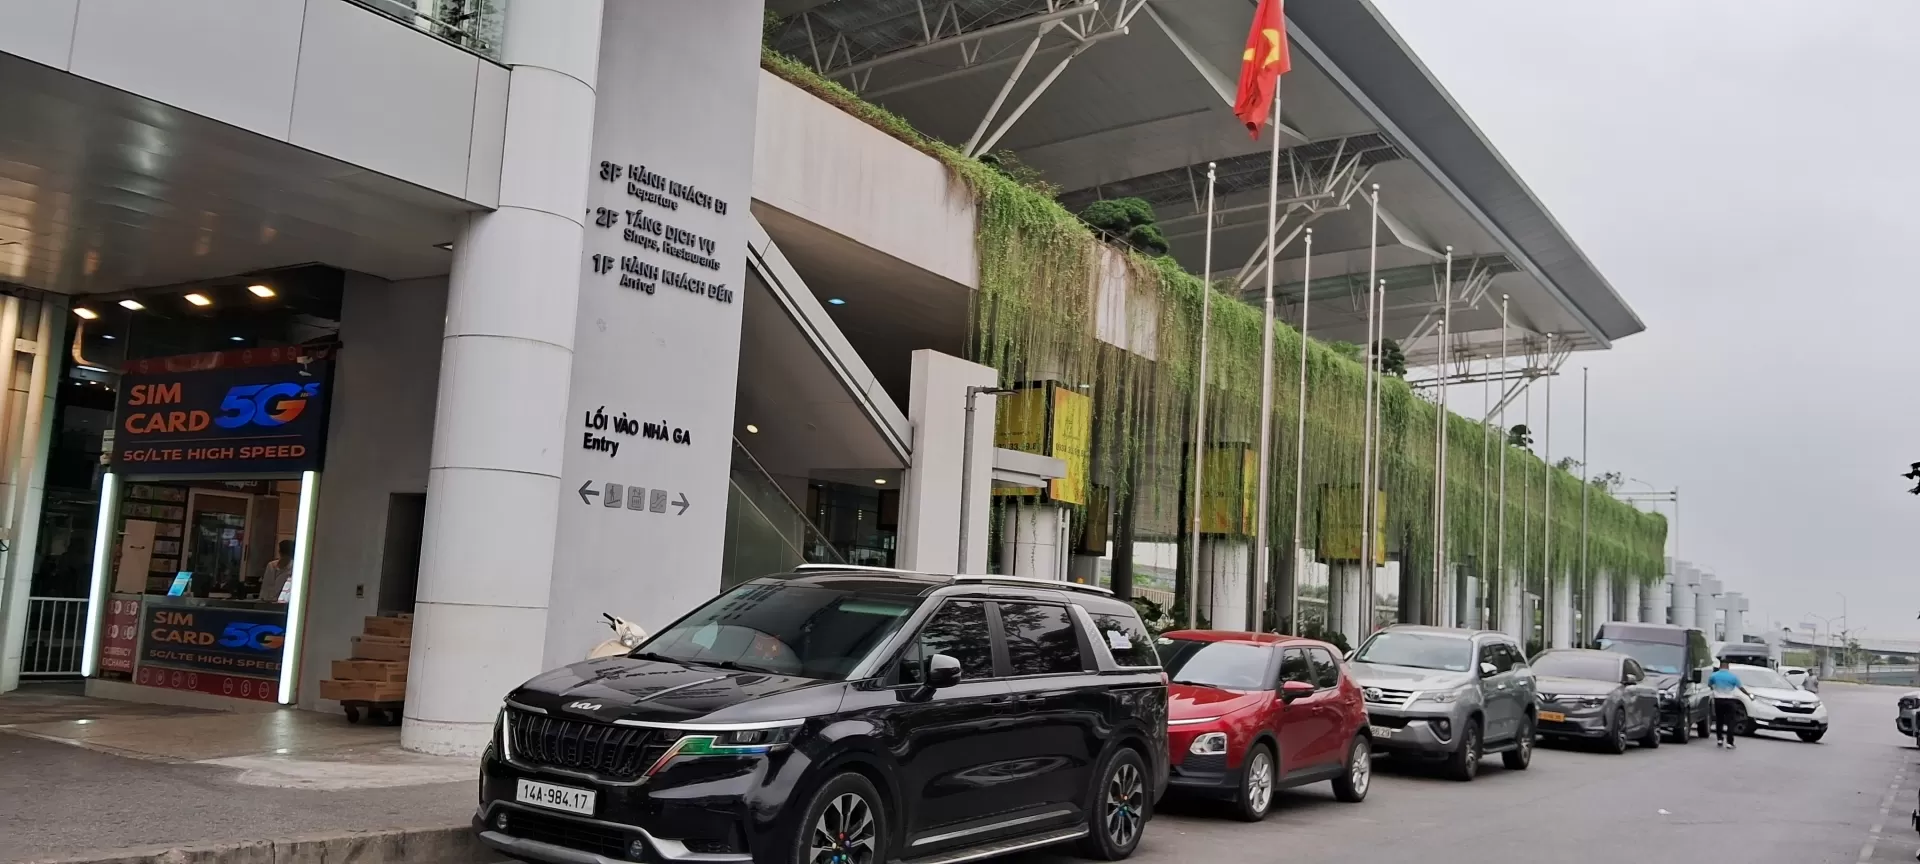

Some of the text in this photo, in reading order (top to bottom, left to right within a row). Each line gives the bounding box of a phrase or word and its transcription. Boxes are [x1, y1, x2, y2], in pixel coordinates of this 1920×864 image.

[599, 161, 623, 183] 3F
[669, 180, 713, 209] KHÁCH
[714, 199, 728, 216] ĐI
[627, 182, 679, 211] Departure
[595, 206, 619, 229] 2F
[665, 224, 697, 248] DỊCH
[698, 236, 717, 256] VỤ
[623, 227, 721, 271] Shops, Restaurants
[592, 253, 615, 274] 1F
[662, 269, 706, 296] KHÁCH
[708, 282, 734, 304] ĐẾN
[619, 274, 656, 296] Arrival
[128, 382, 182, 406] SIM
[124, 410, 210, 434] CARD
[585, 405, 691, 446] LỐI VÀO NHÀ GA
[123, 444, 306, 462] 5G/LTE HIGH SPEED
[583, 432, 620, 458] Entry
[153, 611, 193, 627] SIM
[151, 628, 215, 646] CARD
[149, 649, 193, 661] 5G/LTE
[198, 654, 233, 666] HIGH
[569, 701, 603, 711] KIA
[523, 784, 588, 809] 14A-984.17
